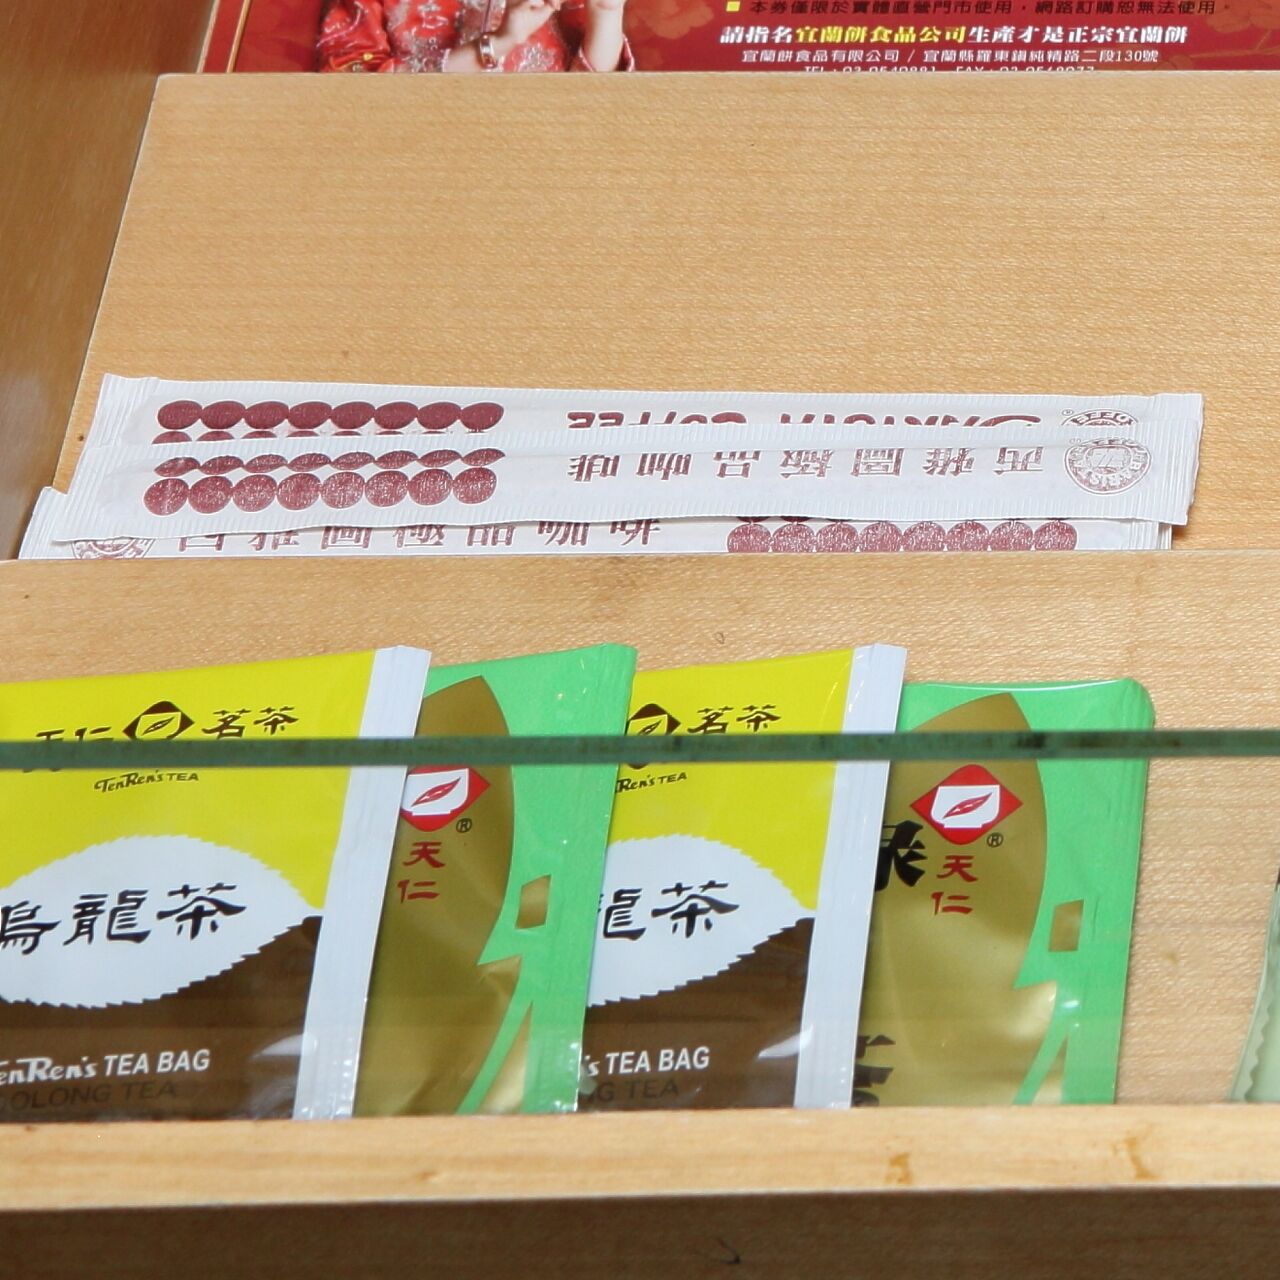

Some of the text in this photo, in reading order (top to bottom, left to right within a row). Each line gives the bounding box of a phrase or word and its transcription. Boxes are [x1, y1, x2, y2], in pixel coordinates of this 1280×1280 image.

[719, 25, 1188, 44] 請指名宜蘭餅食品公司生產才是正宗宜蘭餅
[166, 772, 200, 782] TEA
[657, 771, 688, 785] TEA
[396, 840, 447, 904] 天仁
[930, 853, 979, 916] 天仁
[0, 881, 247, 956] 烏龍茶
[0, 1048, 211, 1086] enRen's TEA BAG
[605, 1050, 651, 1076] TEA
[657, 1046, 711, 1072] BAG
[120, 1080, 178, 1102] TEA
[621, 1077, 680, 1101] TEA
